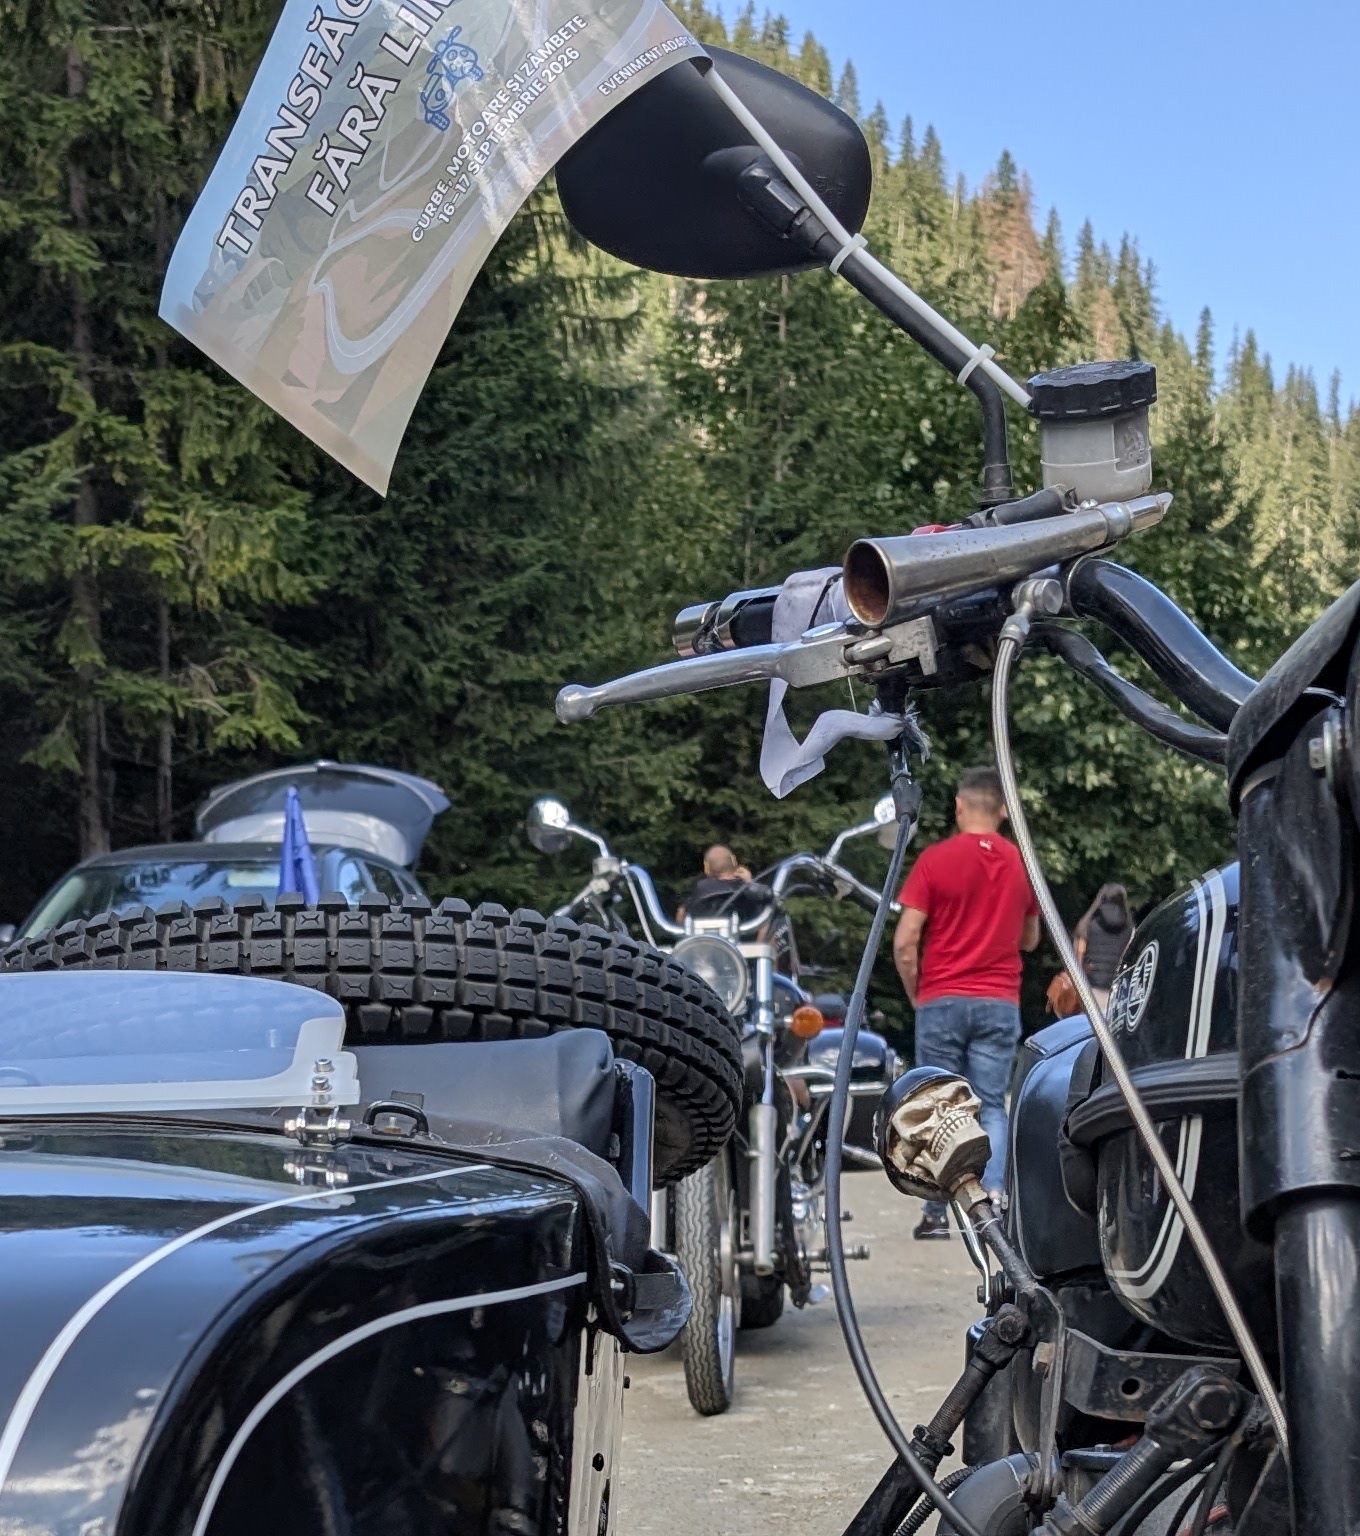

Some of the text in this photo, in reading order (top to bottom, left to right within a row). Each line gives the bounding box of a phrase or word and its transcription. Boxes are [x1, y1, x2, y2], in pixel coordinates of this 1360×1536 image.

[304, 61, 401, 217] FĂRĂ
[411, 179, 454, 242] CURBE,
[445, 88, 510, 179] MOTOARE
[518, 14, 588, 78] ZÂMBETE
[466, 77, 547, 176] SEPTEMBRIE
[540, 46, 580, 84] 2026
[597, 45, 664, 97] EVENIMENT
